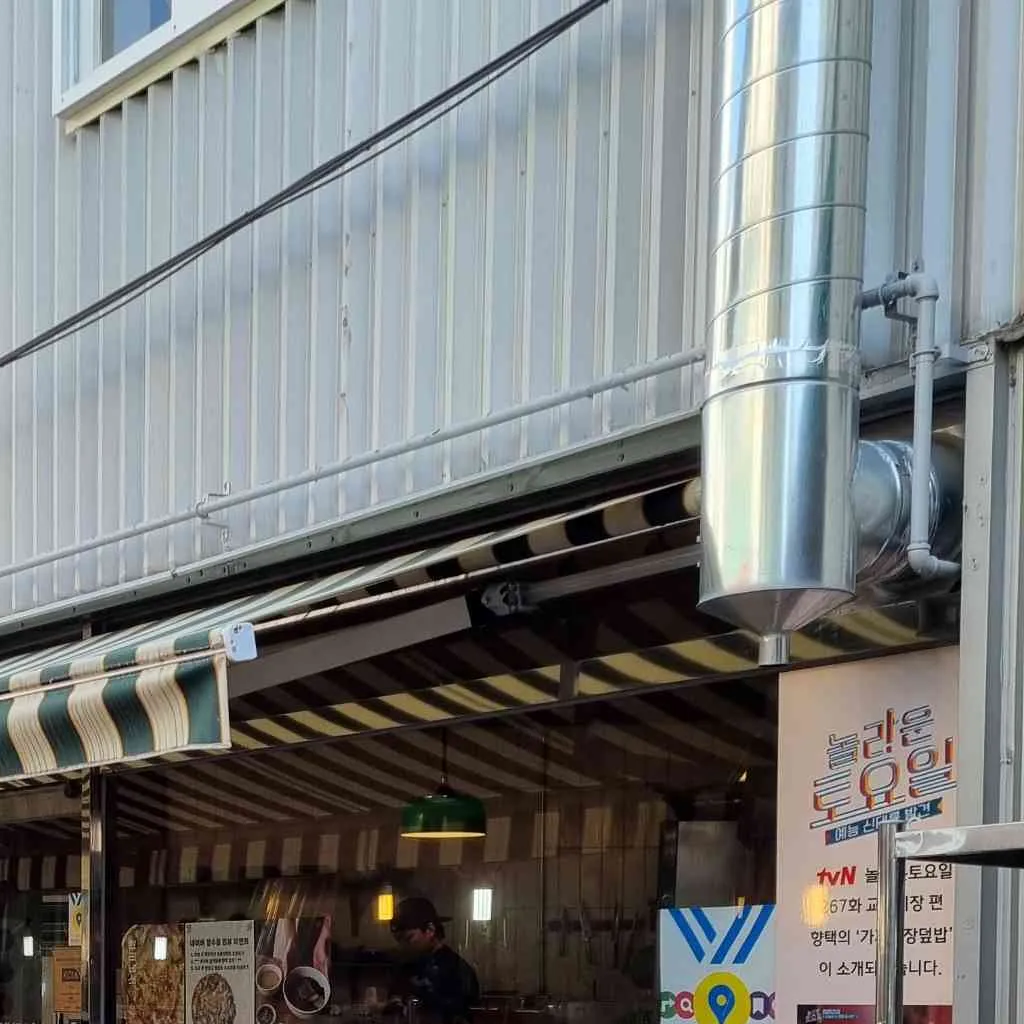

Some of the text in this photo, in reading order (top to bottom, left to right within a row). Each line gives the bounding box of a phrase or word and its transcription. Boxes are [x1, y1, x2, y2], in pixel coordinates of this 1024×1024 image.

[809, 735, 958, 830] 토요일
[816, 866, 856, 886] tvN
[929, 893, 943, 911] 편
[811, 929, 850, 947] 향택의
[819, 961, 832, 977] 이
